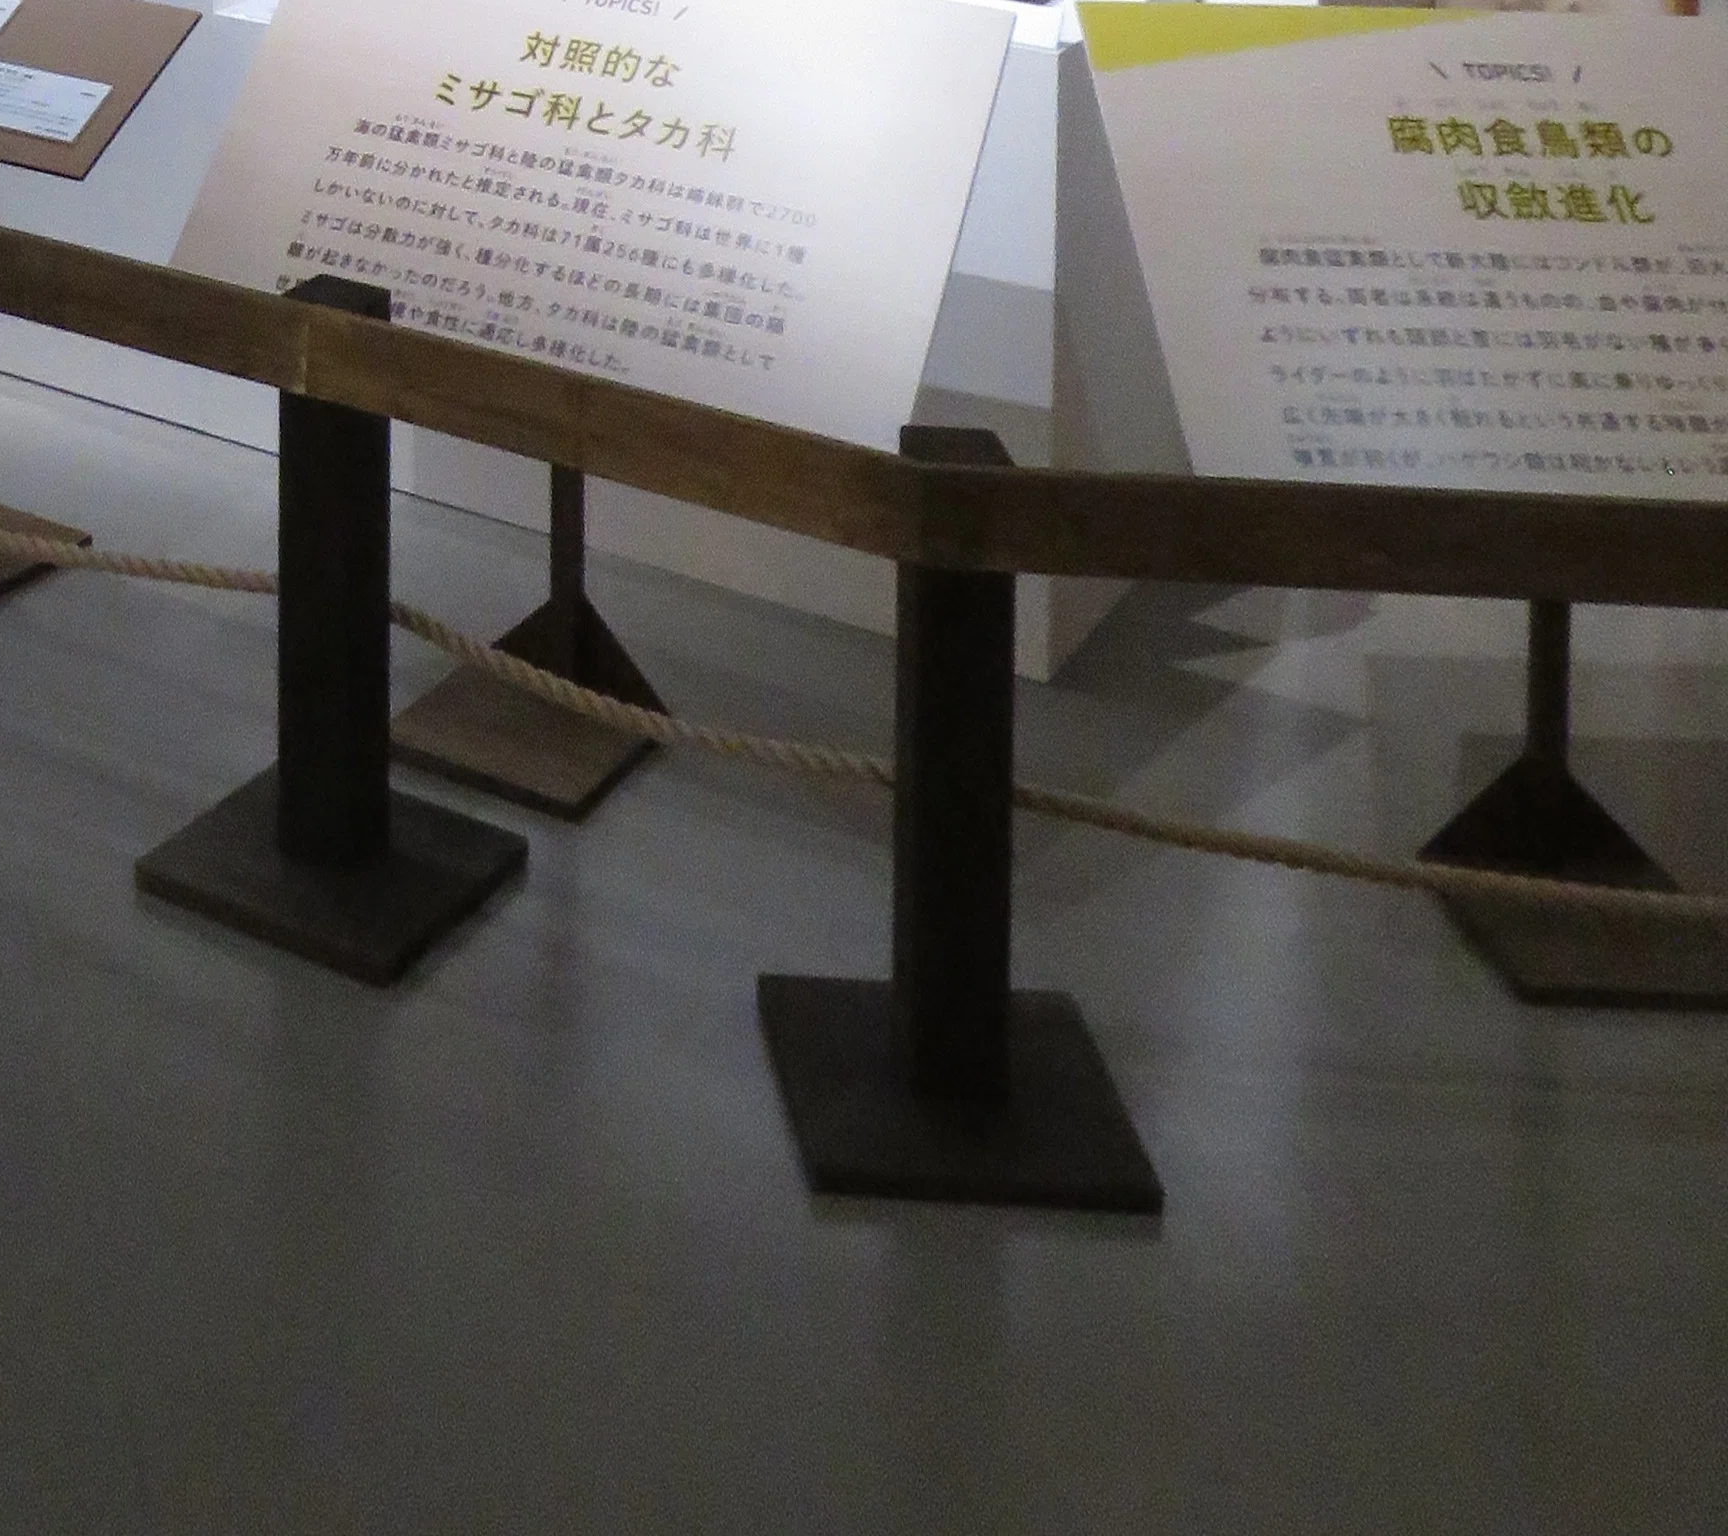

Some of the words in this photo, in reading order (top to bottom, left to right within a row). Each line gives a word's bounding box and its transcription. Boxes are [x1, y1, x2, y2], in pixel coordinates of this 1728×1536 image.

[519, 29, 685, 89] 対照的な
[433, 72, 740, 164] ミサゴ科とタカ科
[1386, 115, 1675, 159] 腐肉食鳥類の
